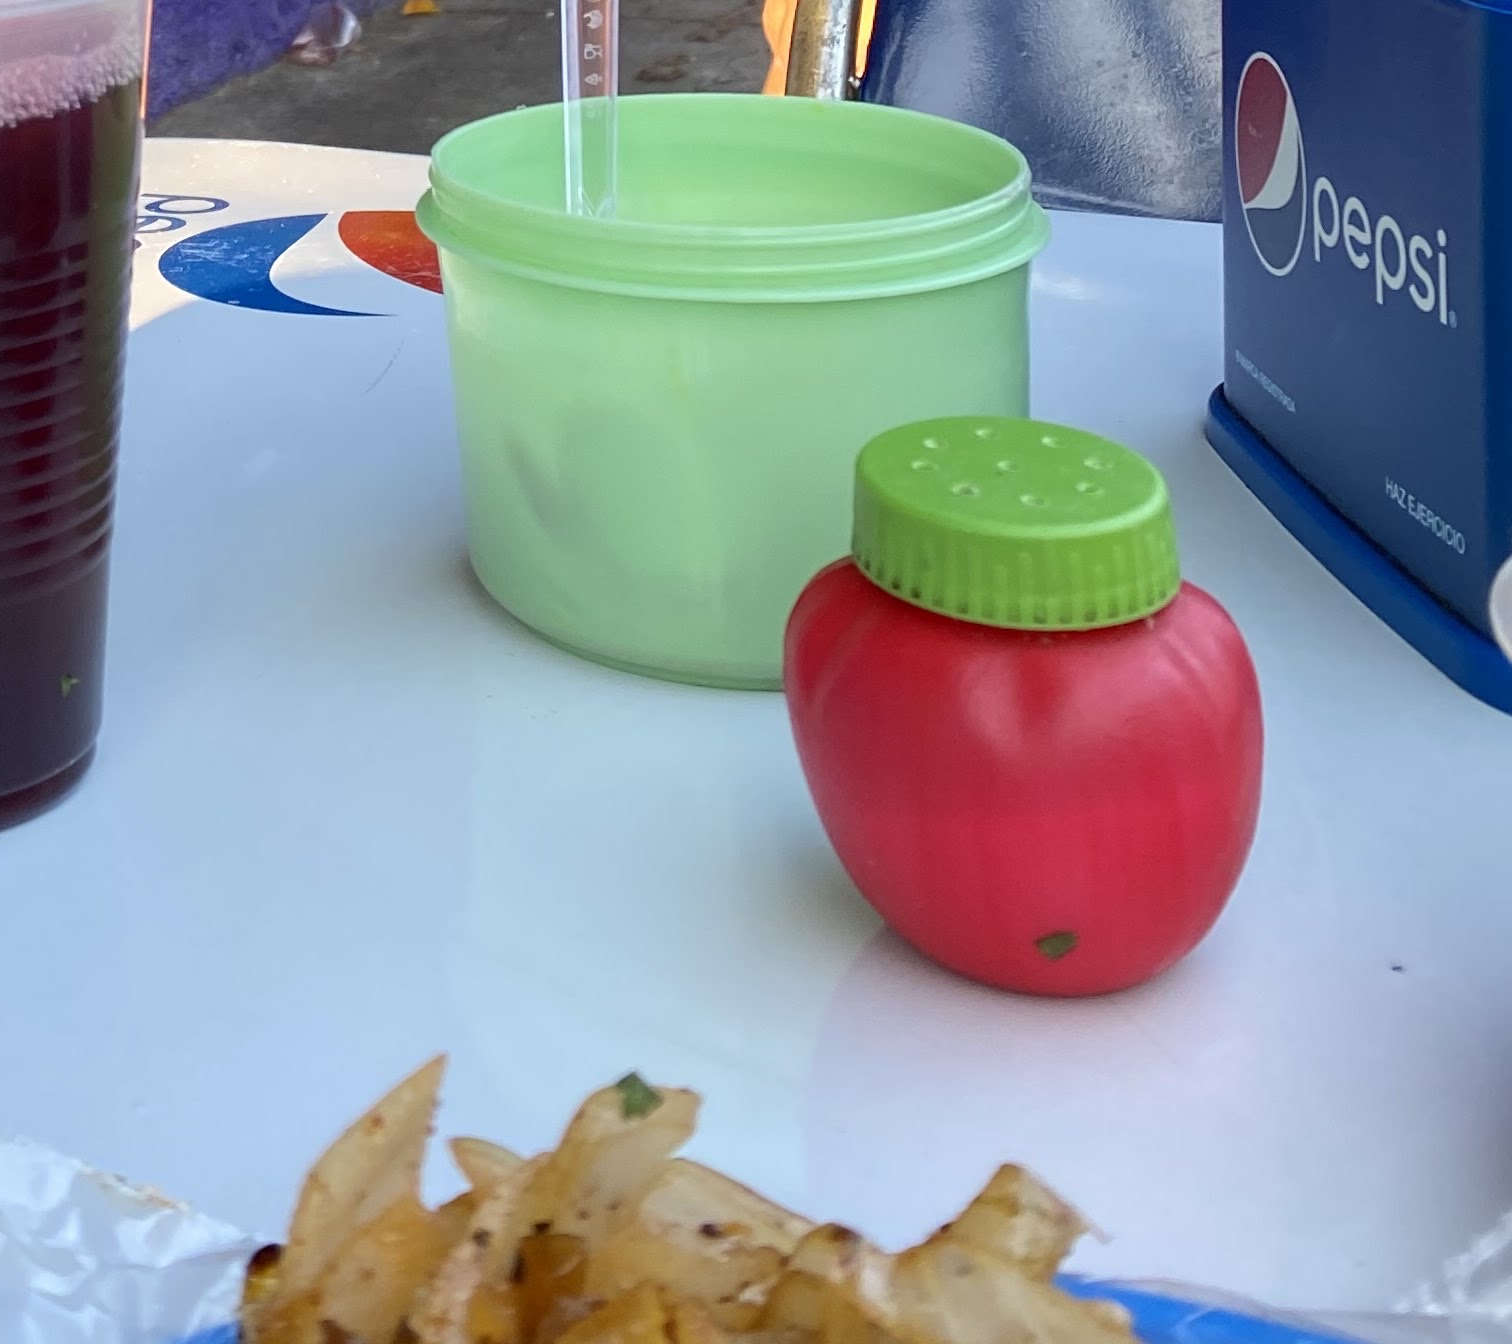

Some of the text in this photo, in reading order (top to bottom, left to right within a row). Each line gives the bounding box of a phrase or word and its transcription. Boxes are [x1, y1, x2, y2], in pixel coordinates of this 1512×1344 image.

[1313, 176, 1449, 326] pepsi
[1385, 476, 1466, 555] HAZ EJERCICIO
